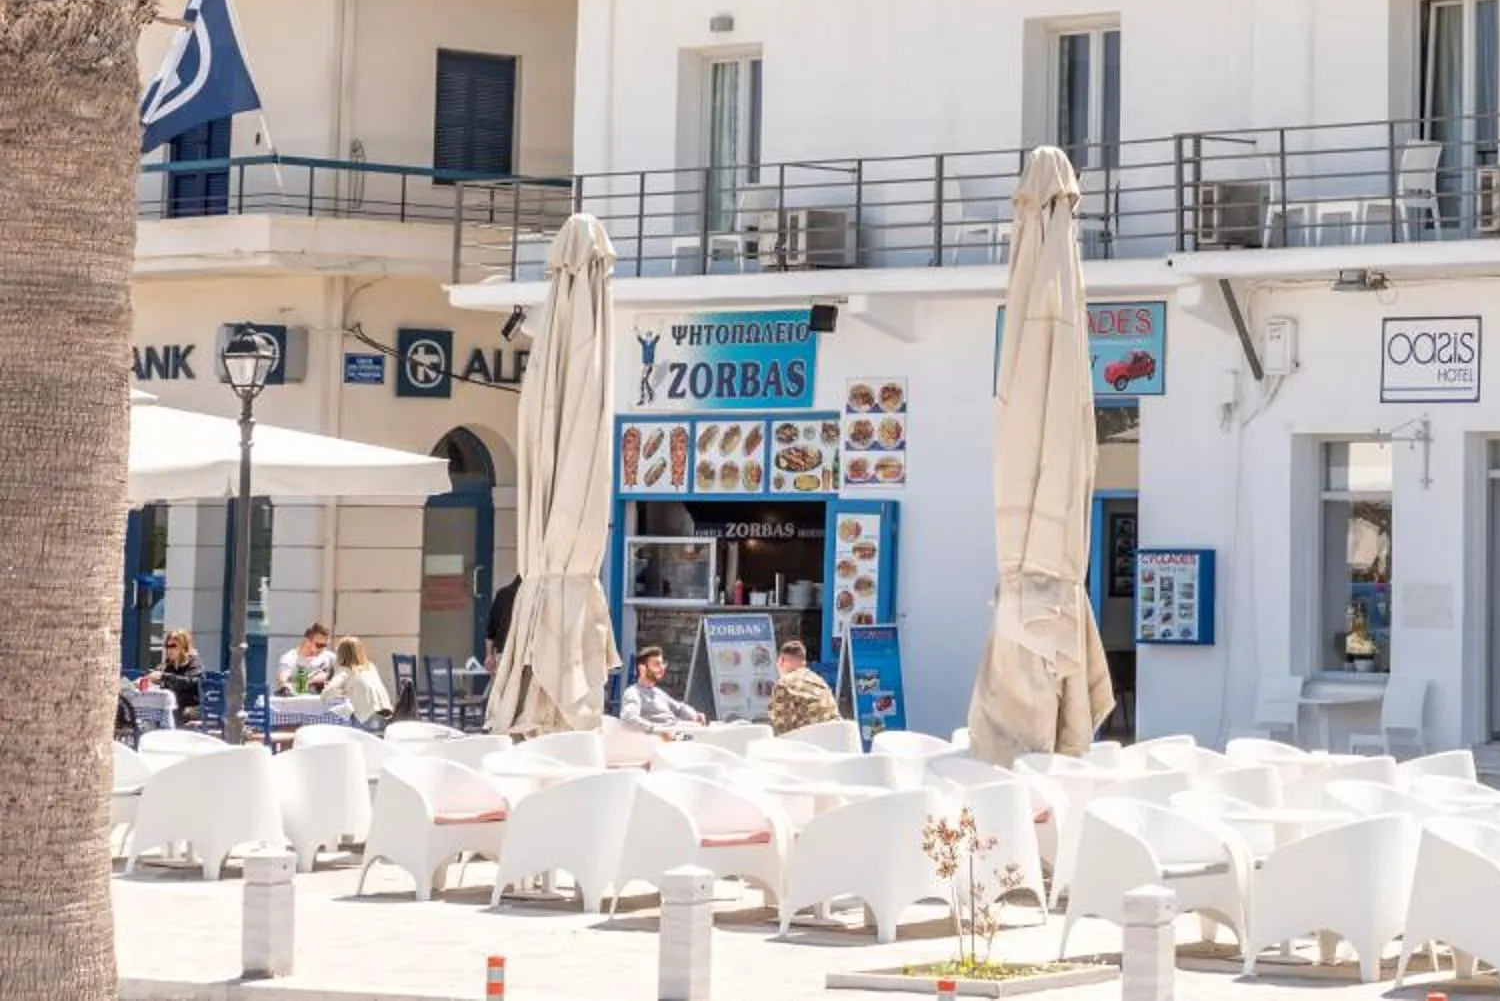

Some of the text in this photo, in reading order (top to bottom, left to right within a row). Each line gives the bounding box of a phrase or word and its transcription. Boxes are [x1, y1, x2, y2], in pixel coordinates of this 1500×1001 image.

[671, 321, 811, 346] ΨΗΤΟΠΩΛΕΙΟ
[667, 359, 807, 400] ZORBAS
[1437, 368, 1474, 383] HOTEL
[725, 522, 796, 538] ZORBAS
